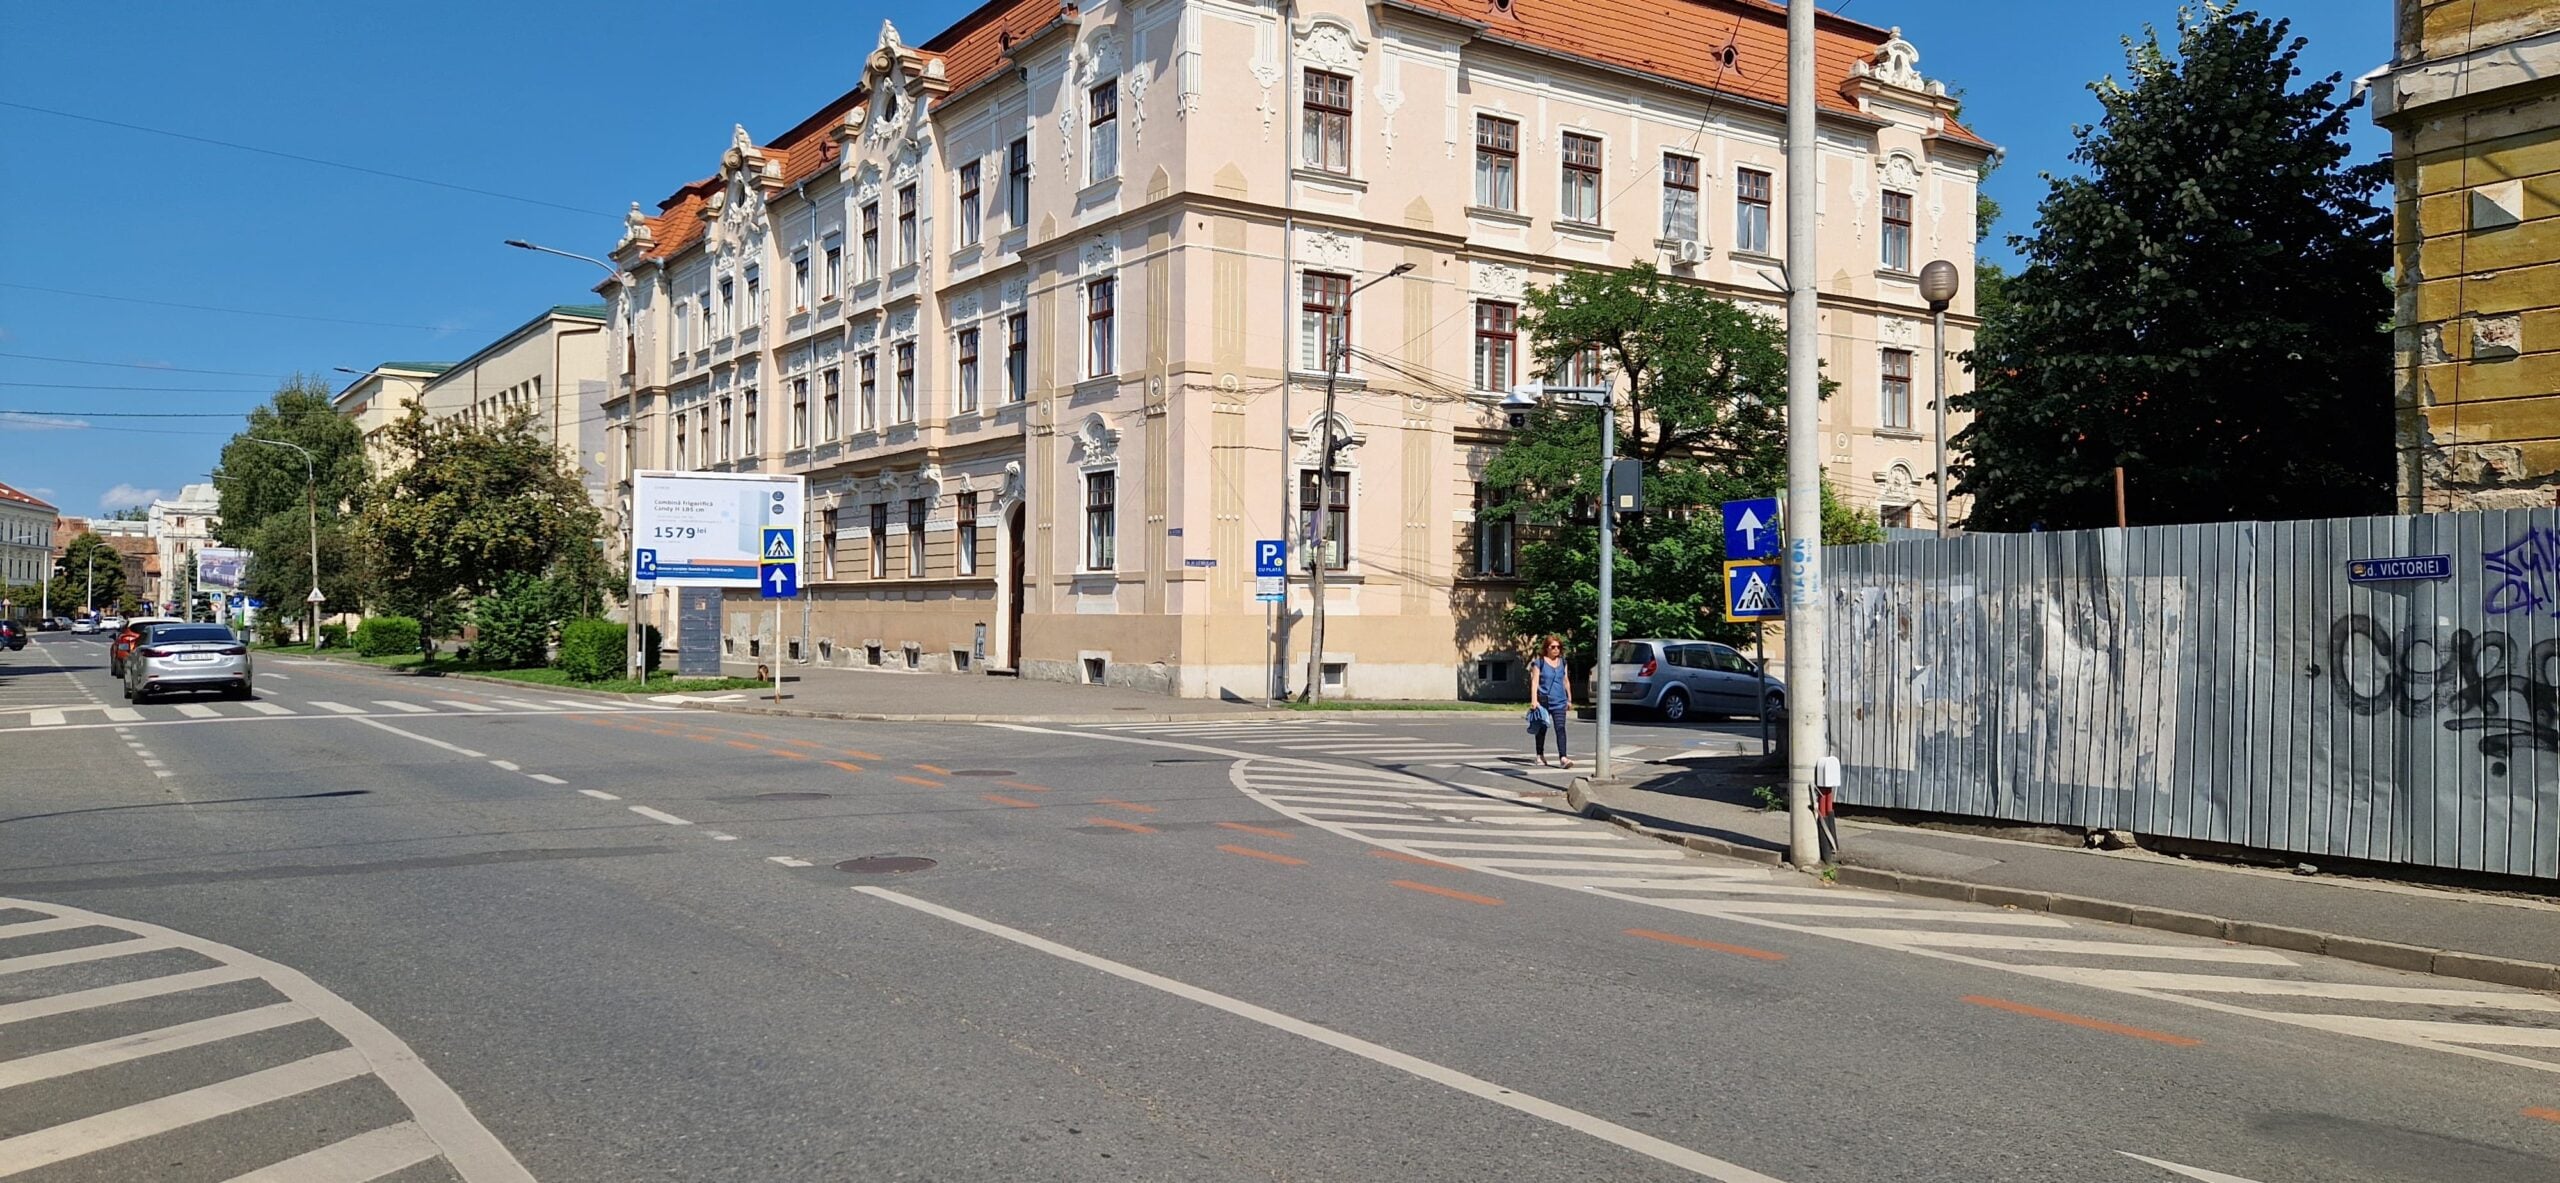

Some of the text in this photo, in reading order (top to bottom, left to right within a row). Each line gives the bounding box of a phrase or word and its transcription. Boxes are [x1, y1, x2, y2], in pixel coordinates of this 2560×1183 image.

[654, 526, 696, 539] 1579
[640, 551, 652, 569] P
[1262, 544, 1278, 565] P
[2380, 560, 2440, 576] VICTORIEI
